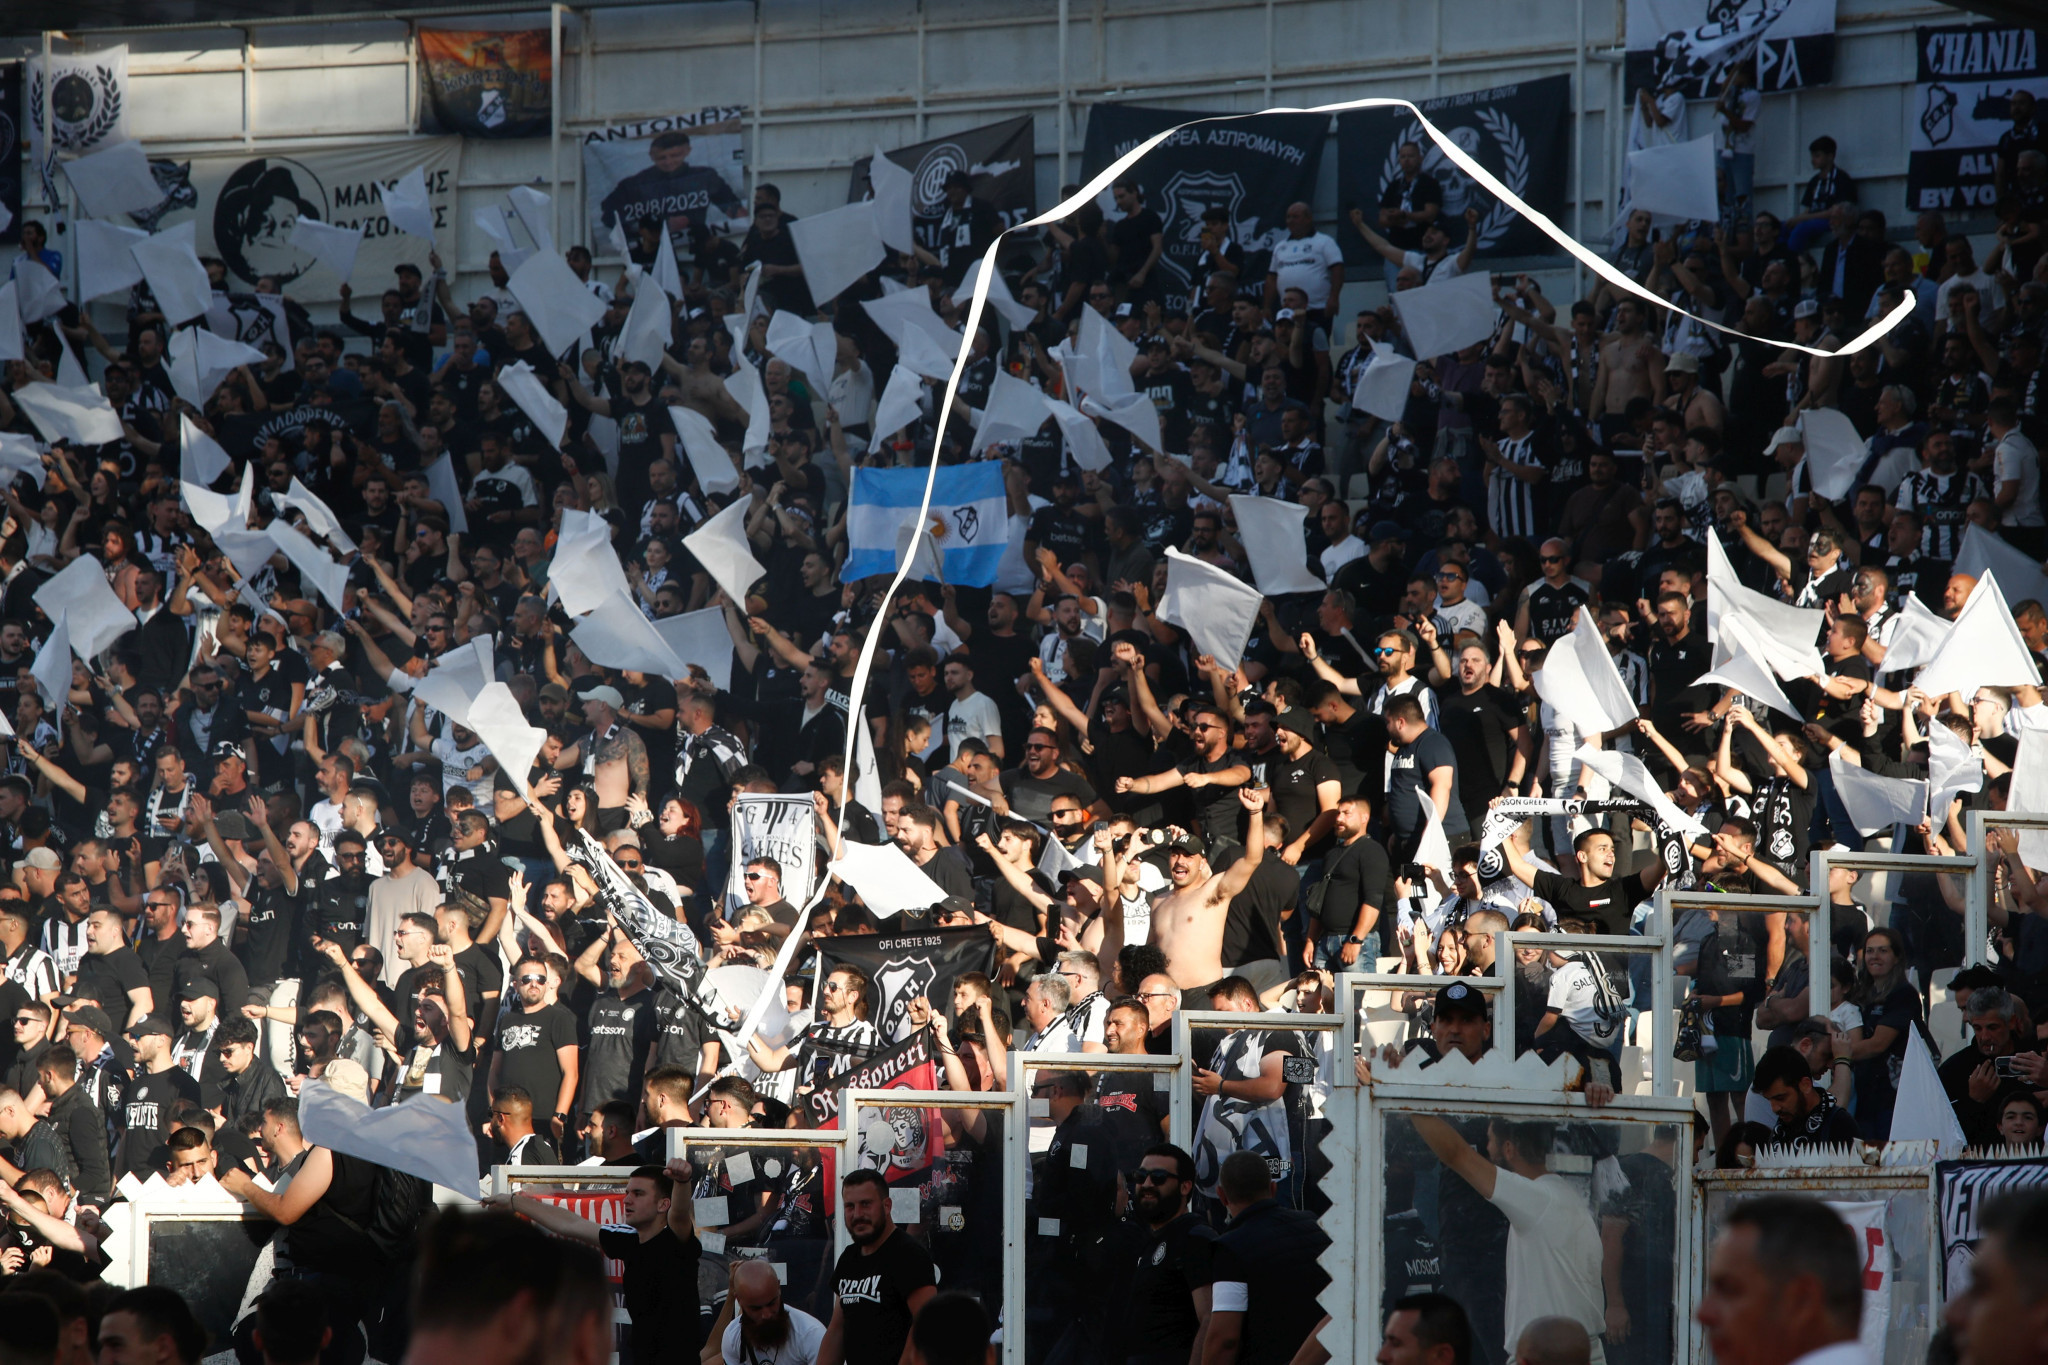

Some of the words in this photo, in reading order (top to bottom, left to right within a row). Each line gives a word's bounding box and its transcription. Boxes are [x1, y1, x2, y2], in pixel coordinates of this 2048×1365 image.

[1926, 28, 2037, 75] CHANIA
[1919, 186, 1955, 208] BY
[1616, 798, 1640, 806] FINAL
[789, 807, 798, 825] 4
[879, 940, 894, 951] OFI
[895, 937, 921, 949] CRETE
[923, 935, 942, 947] 1925
